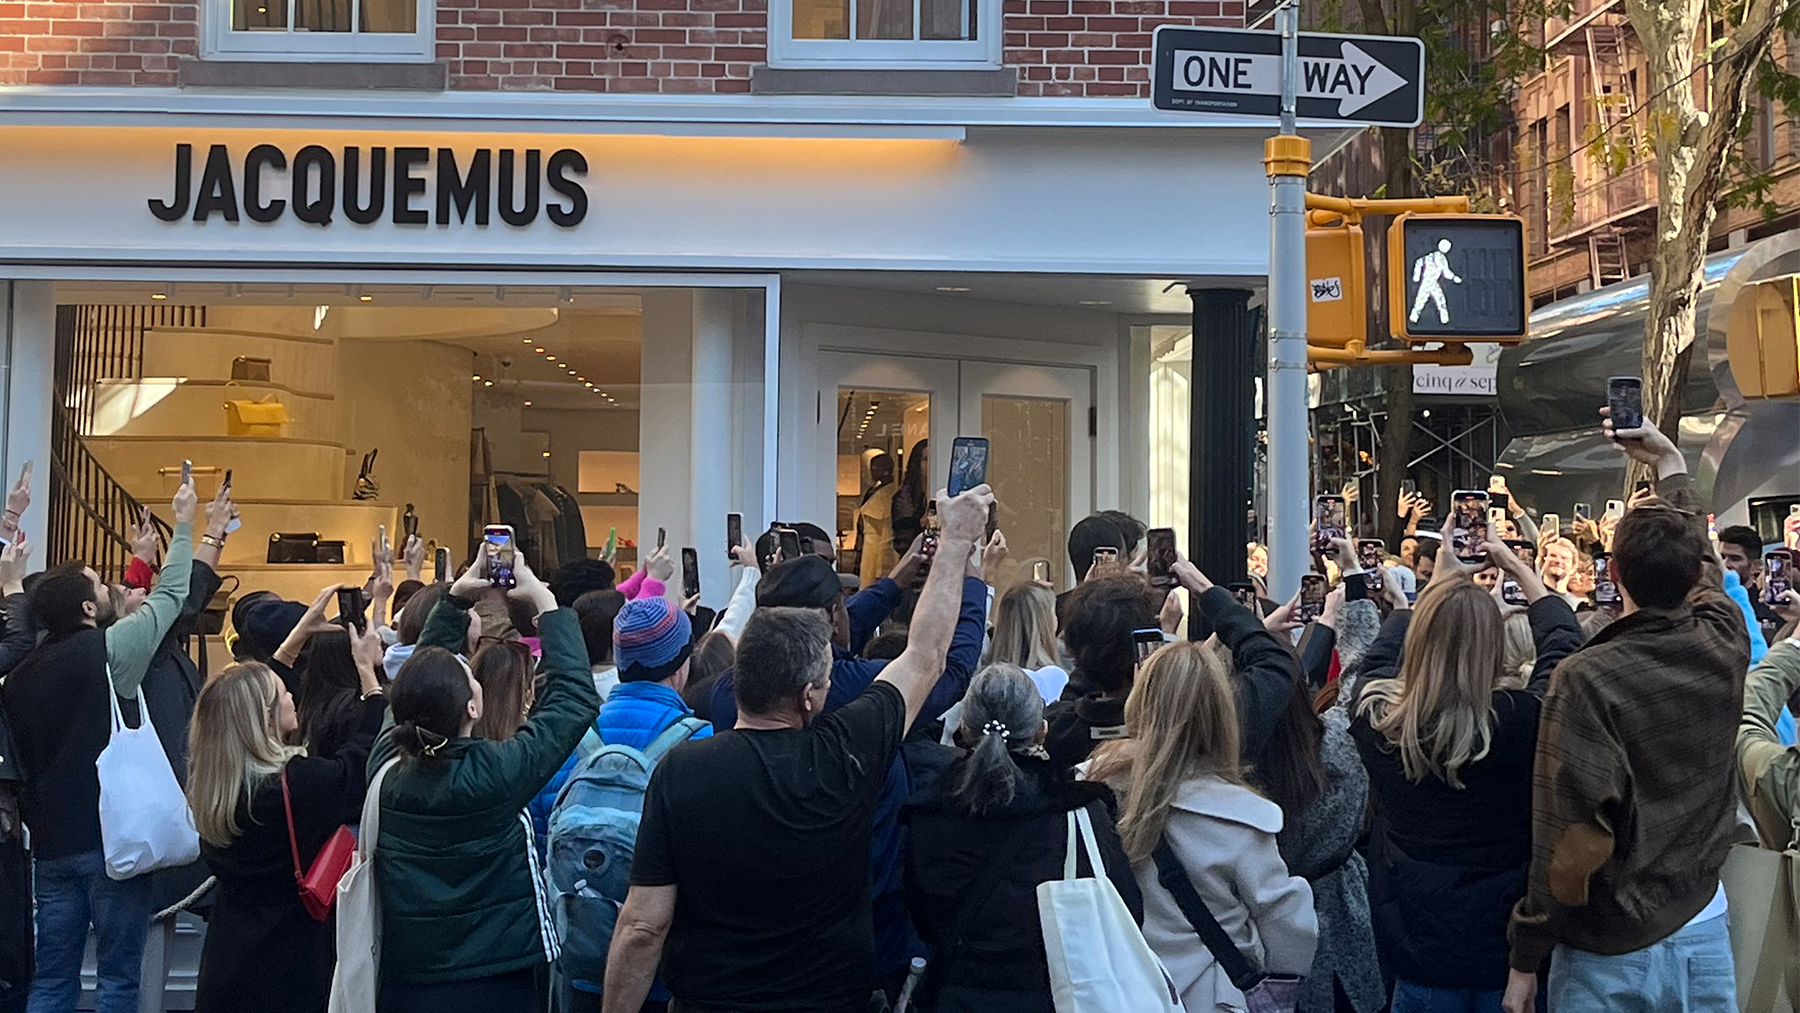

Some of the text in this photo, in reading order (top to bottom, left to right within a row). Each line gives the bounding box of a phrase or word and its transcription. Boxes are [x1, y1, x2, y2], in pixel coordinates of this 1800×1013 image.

[1183, 55, 1376, 96] ONE WAY
[148, 143, 588, 227] JACQUEMUS
[1415, 373, 1452, 392] cinq
